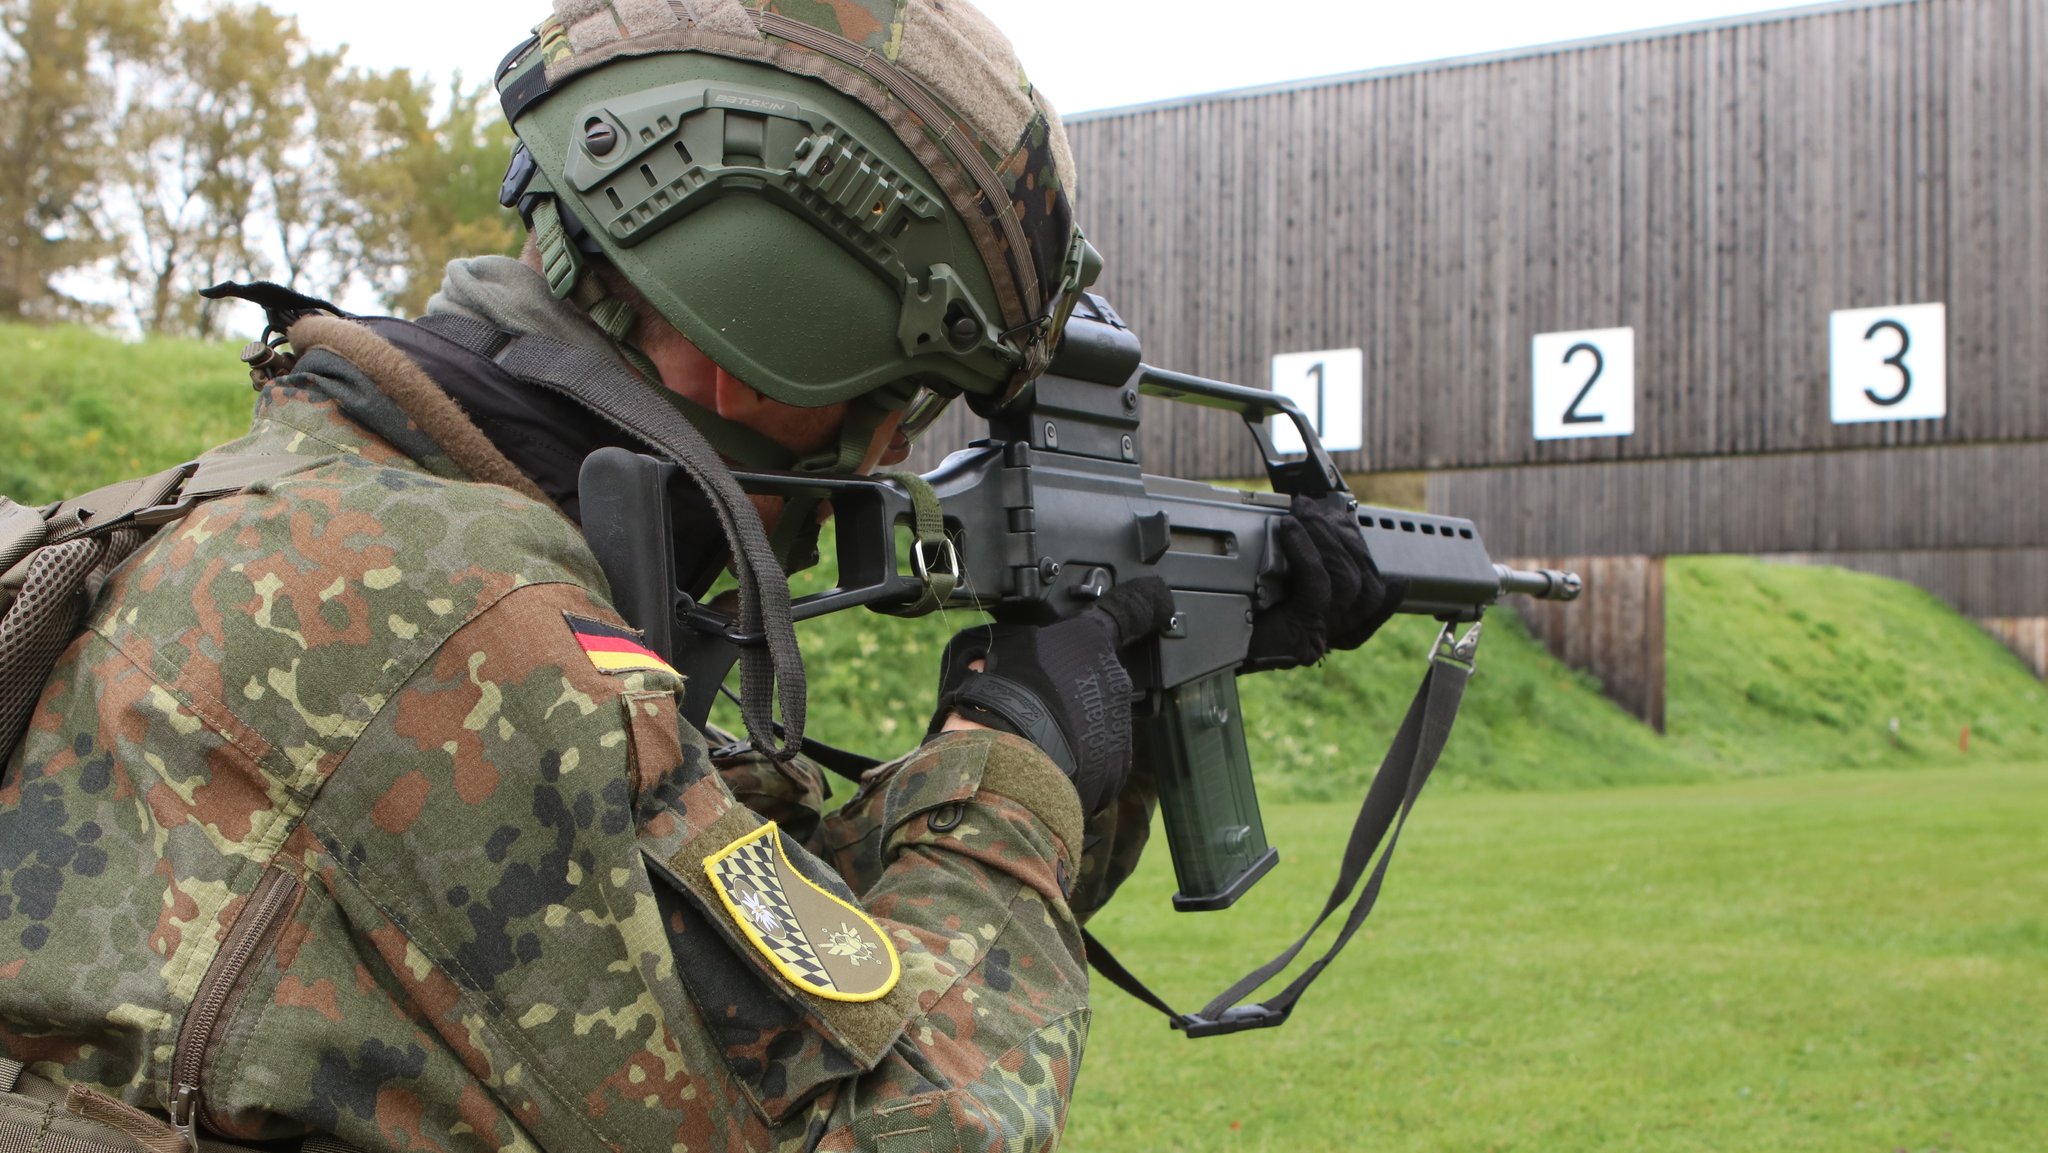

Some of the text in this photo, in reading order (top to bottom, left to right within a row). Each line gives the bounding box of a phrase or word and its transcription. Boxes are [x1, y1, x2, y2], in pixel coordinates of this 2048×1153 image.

[1305, 362, 1324, 439] 1
[1561, 343, 1604, 424] 2
[1863, 320, 1912, 405] 3
